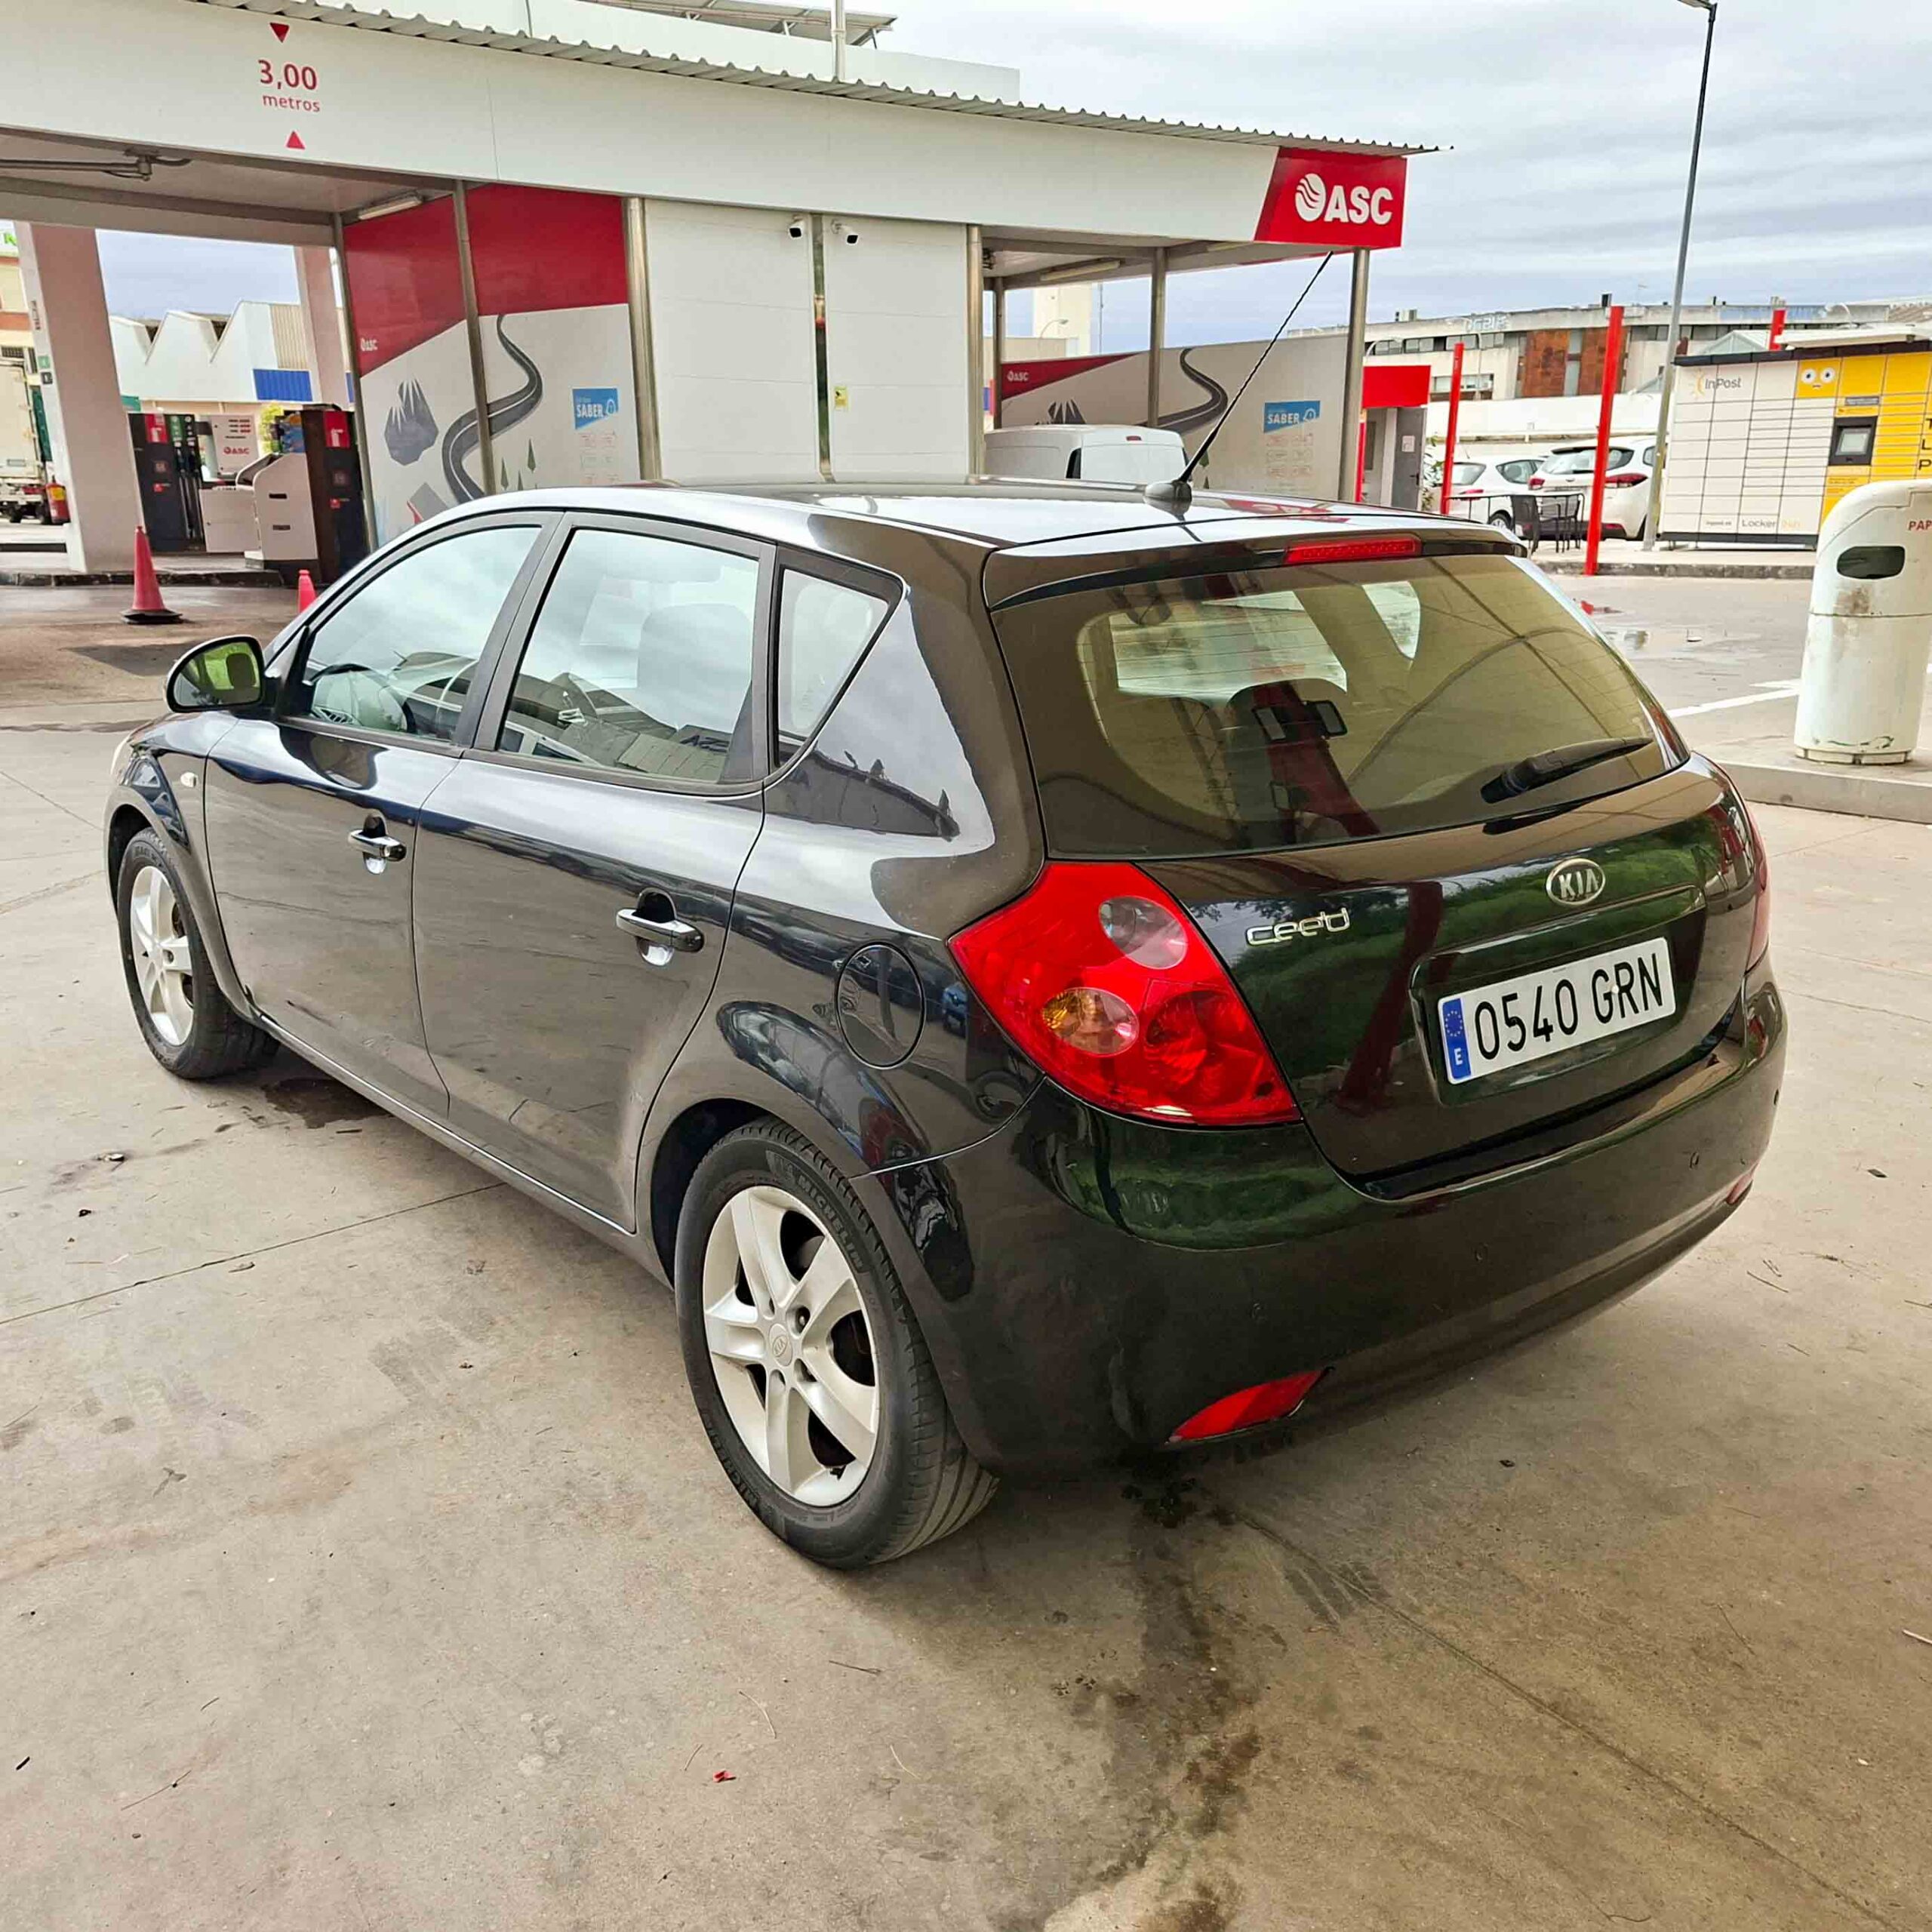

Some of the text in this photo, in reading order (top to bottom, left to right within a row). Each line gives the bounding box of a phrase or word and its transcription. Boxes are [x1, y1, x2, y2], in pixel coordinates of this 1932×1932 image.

[257, 59, 317, 91] 3,00
[262, 95, 321, 112] metros
[1324, 185, 1393, 226] ASC
[1706, 377, 1741, 389] InPost
[1268, 413, 1300, 424] SABER
[1742, 519, 1777, 528] Locker
[1474, 952, 1663, 1060] 0540 GRN
[1454, 1047, 1463, 1066] E
